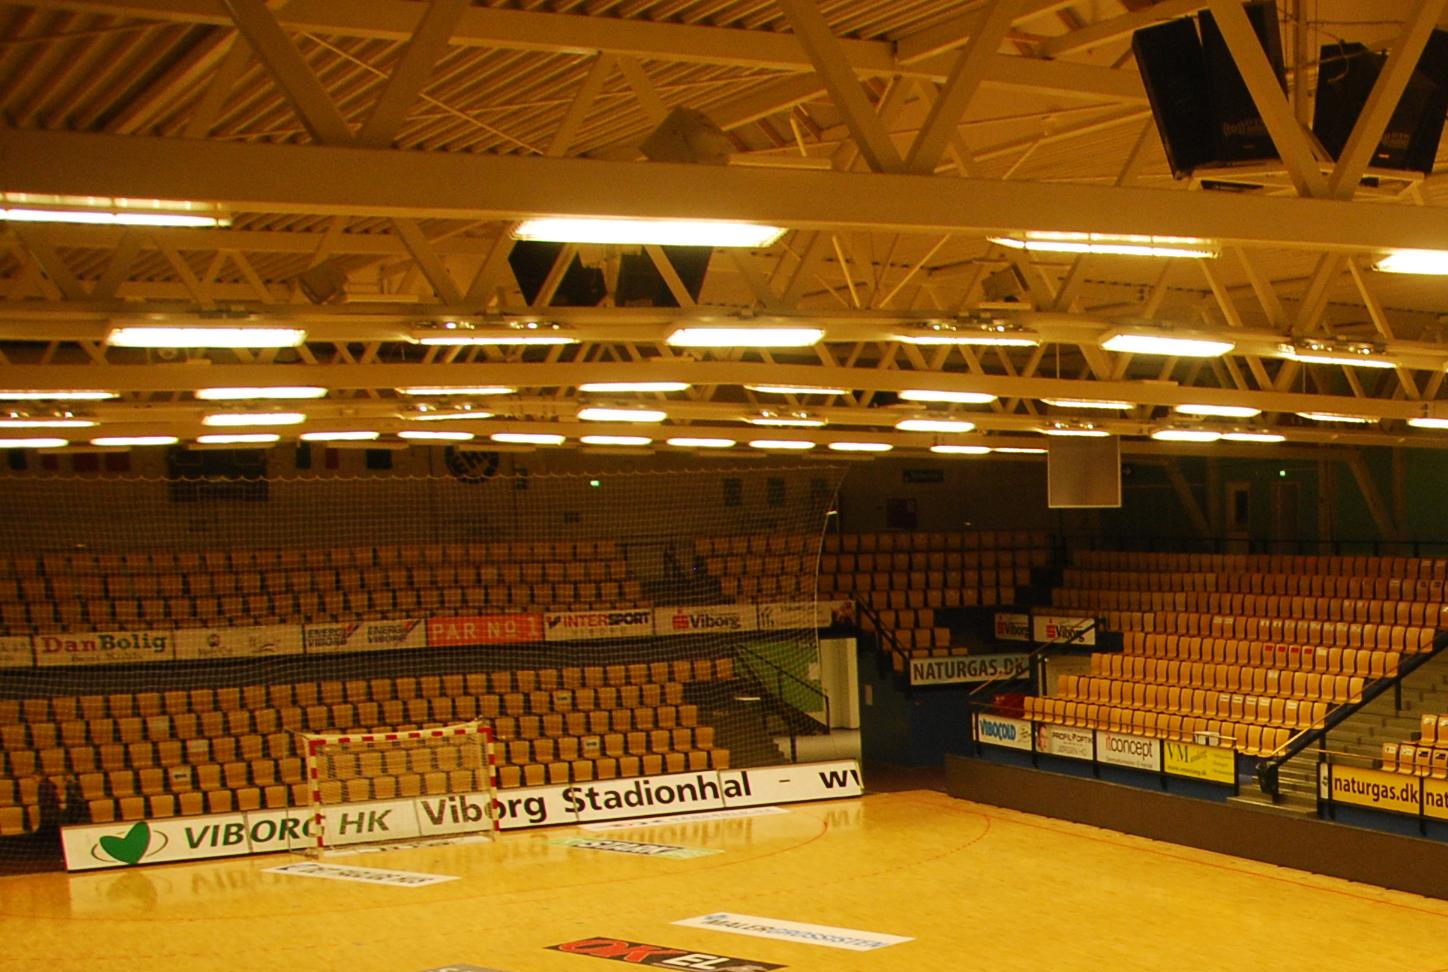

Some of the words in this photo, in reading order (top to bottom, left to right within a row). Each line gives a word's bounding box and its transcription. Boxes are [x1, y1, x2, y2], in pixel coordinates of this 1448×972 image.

[563, 611, 649, 628] INTERSPORT
[689, 614, 741, 629] Viborg
[41, 633, 167, 654] DanBolig
[420, 795, 548, 826] Viborg
[563, 770, 752, 814] Stadionhal
[1334, 775, 1419, 804] naturgas.dk
[339, 808, 392, 836] HK
[558, 939, 688, 963] OK
[662, 953, 730, 971] EL
